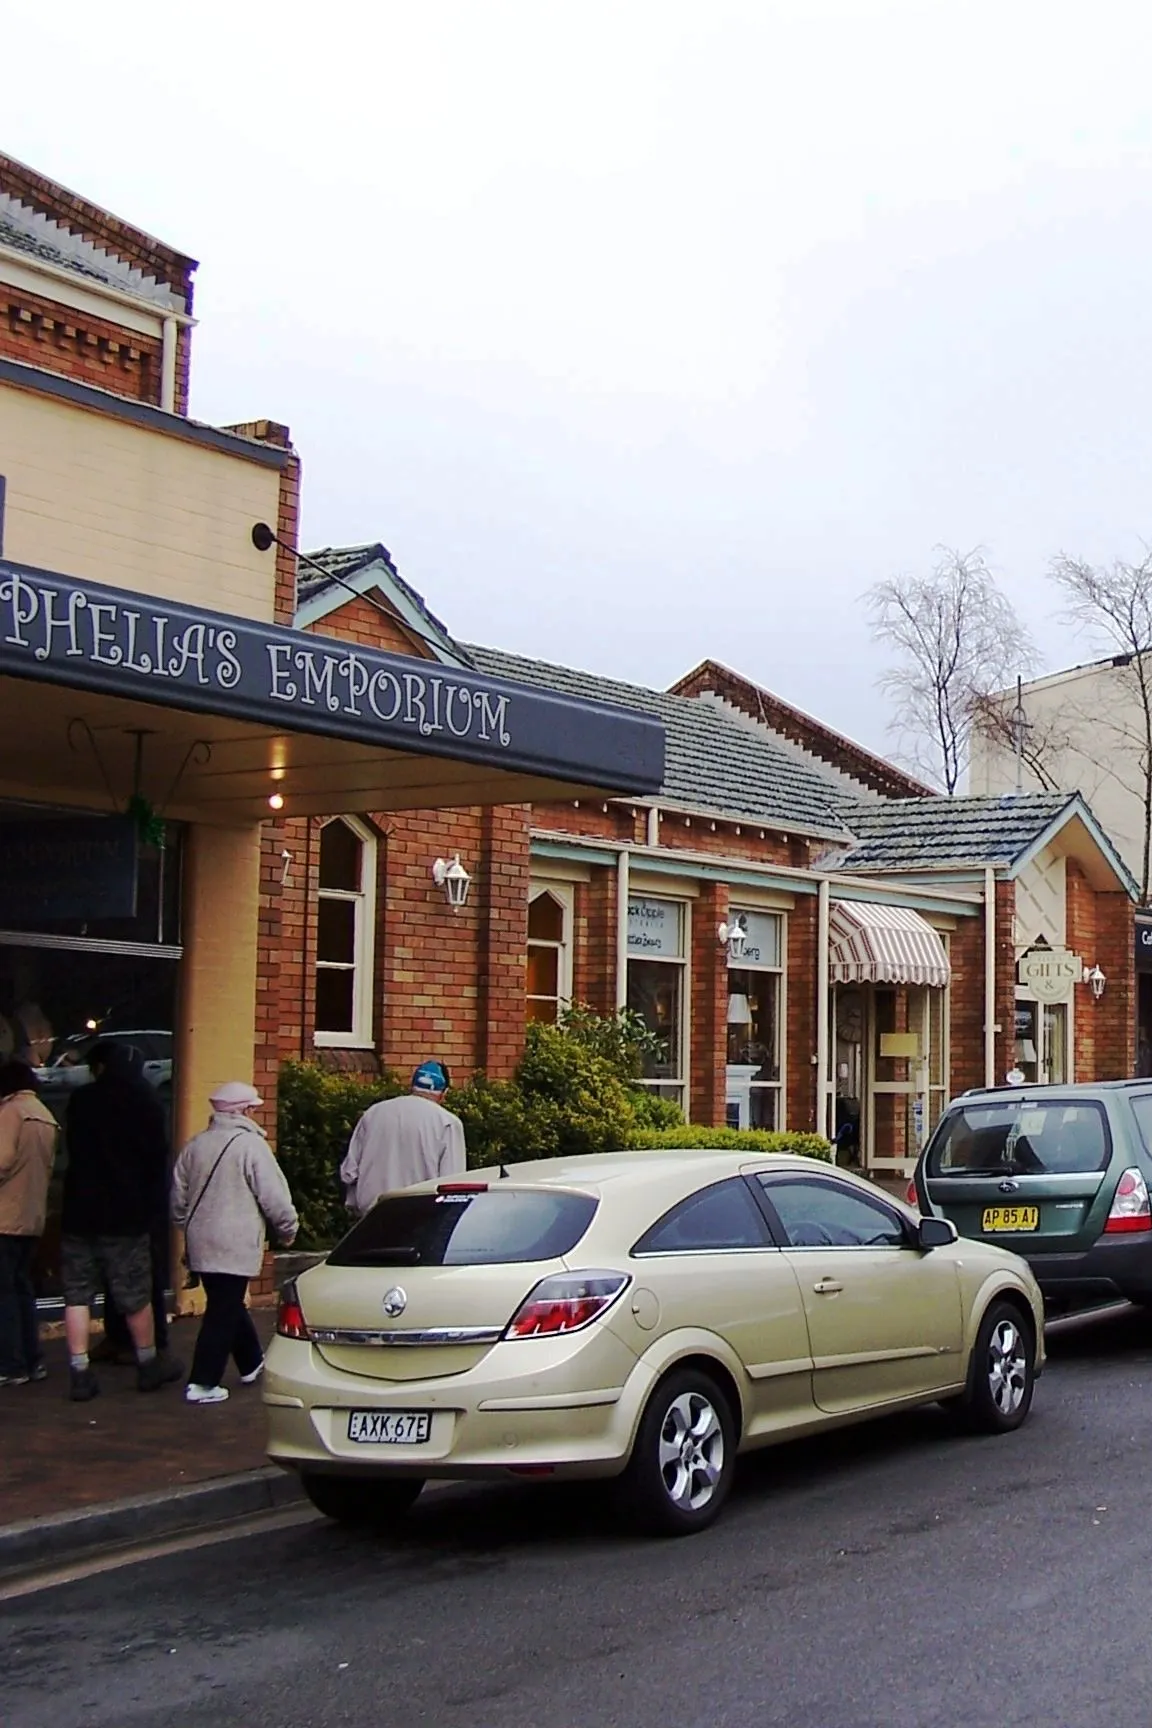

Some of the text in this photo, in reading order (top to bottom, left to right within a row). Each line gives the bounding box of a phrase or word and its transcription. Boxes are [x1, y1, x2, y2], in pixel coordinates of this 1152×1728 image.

[0, 574, 511, 747] PHELIA'S EMPORIUM
[1026, 962, 1075, 977] GIFTS
[984, 1210, 1000, 1224] AP
[1002, 1209, 1018, 1224] 85
